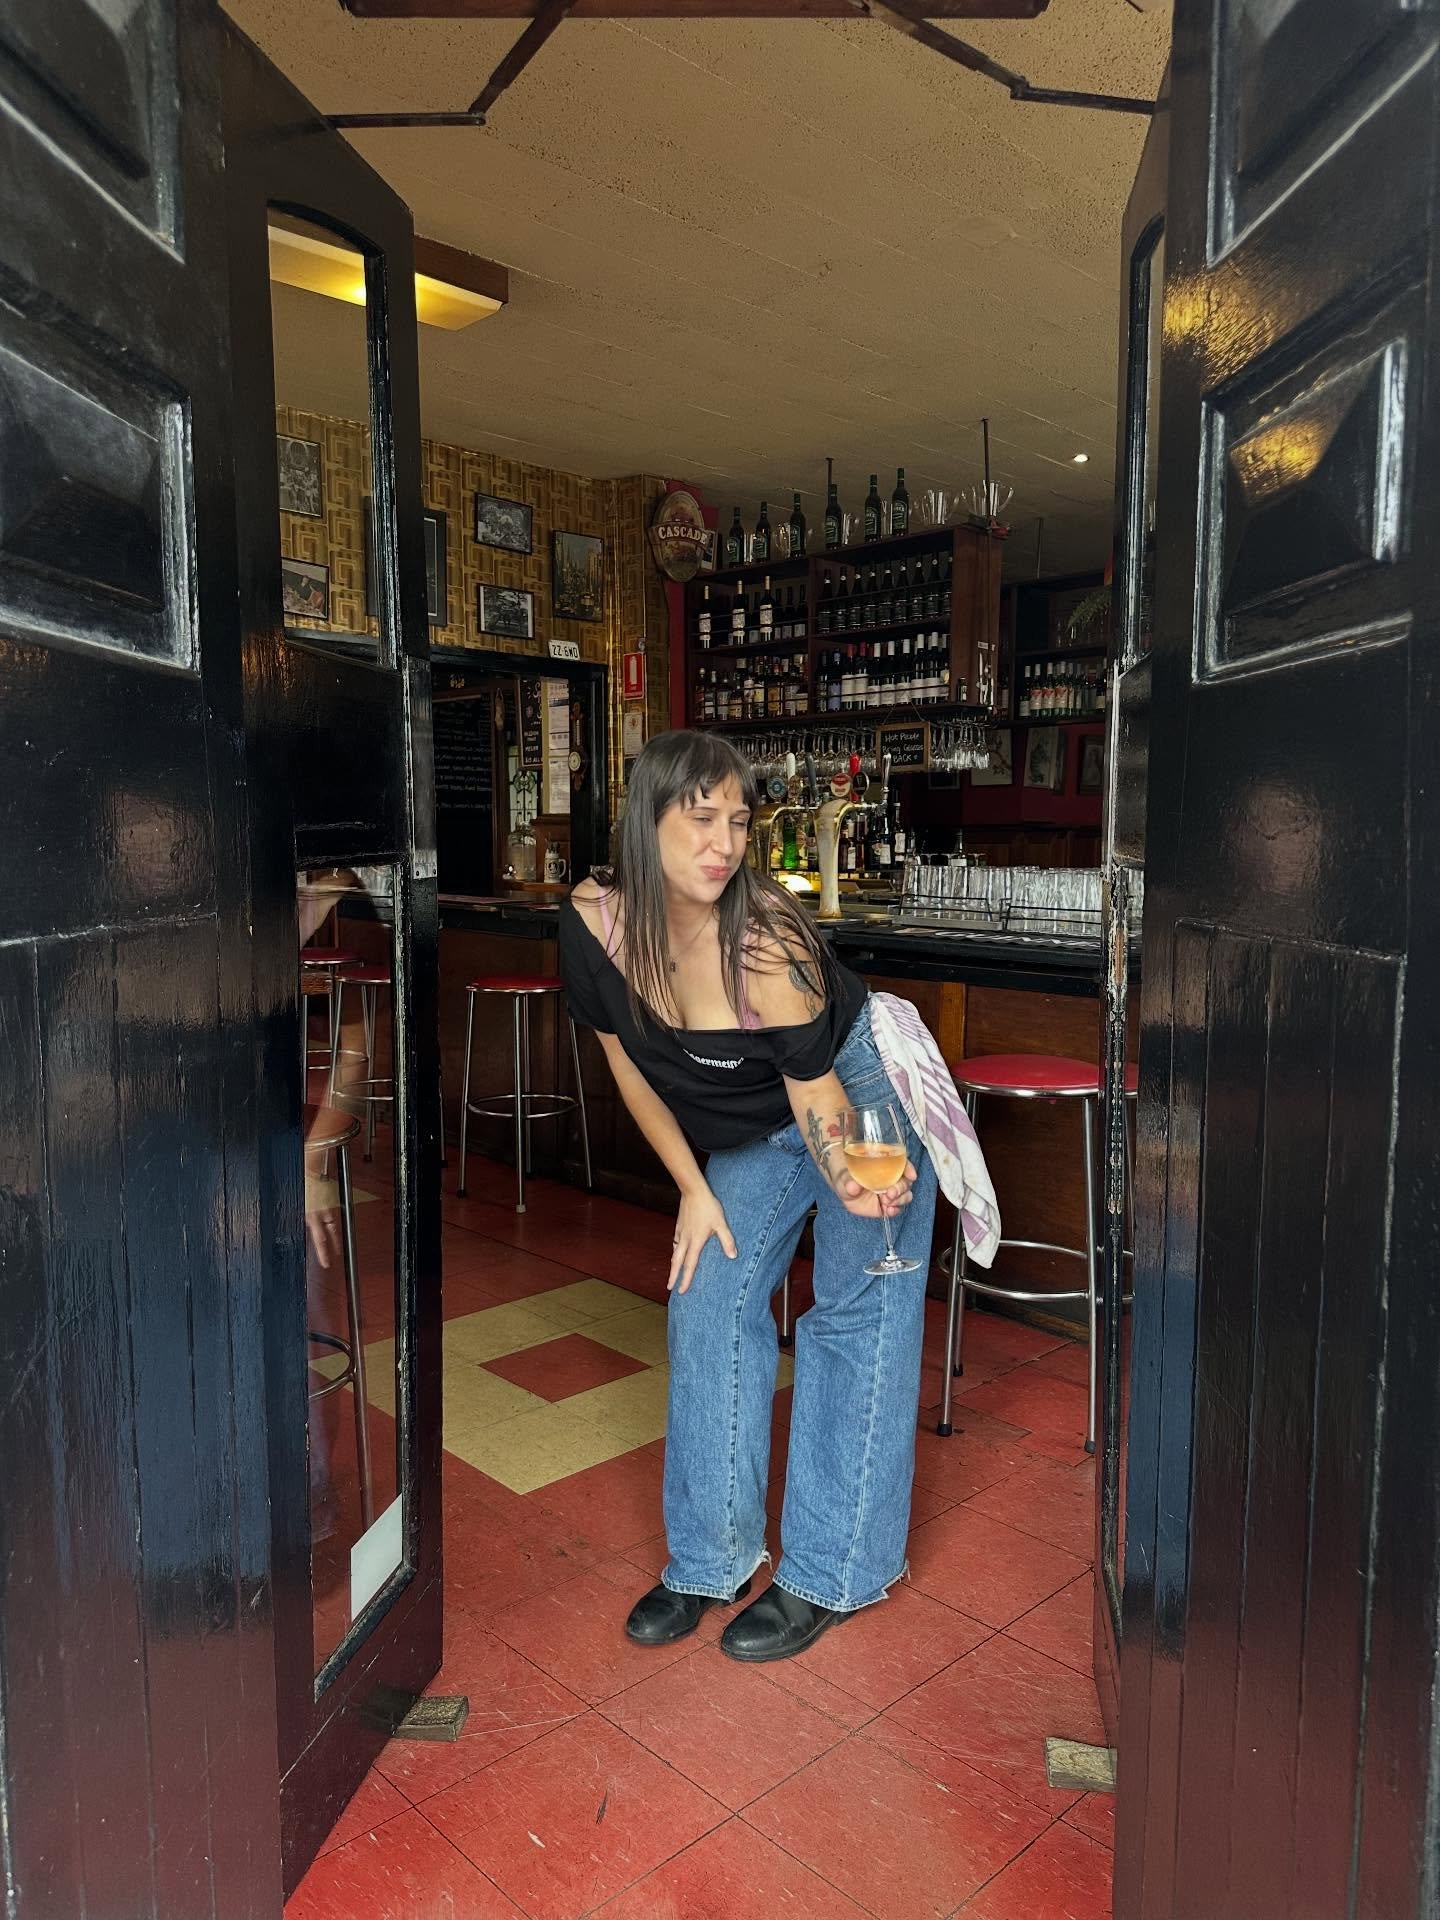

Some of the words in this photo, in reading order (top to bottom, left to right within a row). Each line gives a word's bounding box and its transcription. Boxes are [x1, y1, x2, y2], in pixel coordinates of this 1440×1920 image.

[658, 526, 708, 545] CASCADE
[885, 732, 899, 743] Hot
[900, 732, 920, 741] People
[892, 753, 912, 764] BACK
